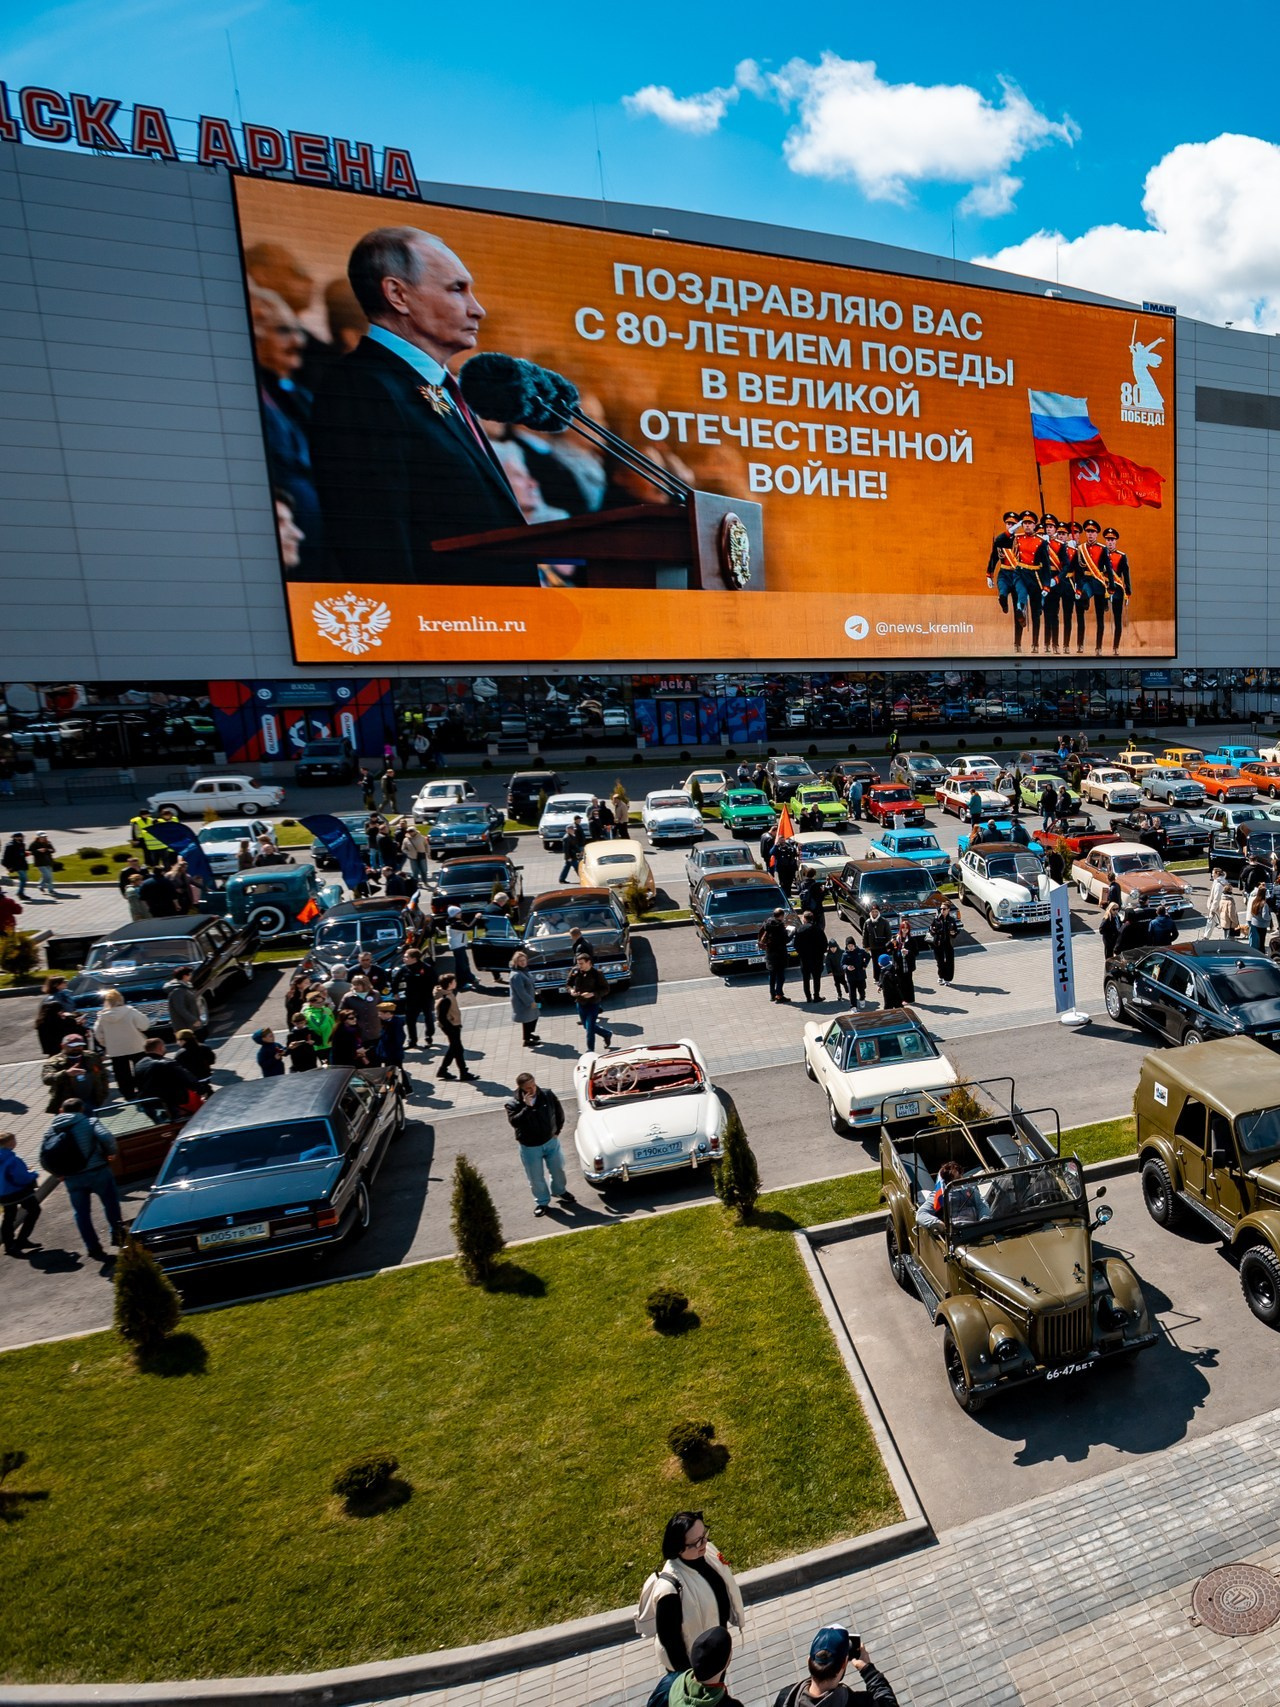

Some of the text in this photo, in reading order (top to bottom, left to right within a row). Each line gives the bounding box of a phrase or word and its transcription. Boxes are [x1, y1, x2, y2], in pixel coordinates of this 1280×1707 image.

[198, 115, 422, 199] АРЕНА
[612, 262, 983, 341] ПОЗДРАВЛЯЮ ВАС
[1150, 303, 1176, 314] MAER
[574, 307, 1015, 389] С 80-ЛЕТИЕМ ПОБЕДЫ
[701, 368, 920, 418] В ВЕЛИКОЙ
[1120, 409, 1165, 427] ПОБЕДА!
[639, 409, 974, 464] ОТЕЧЕСТВЕННОЙ
[748, 460, 888, 500] ВОЙНЕ!
[418, 616, 527, 632] kremlin.ru
[875, 621, 974, 635] @news_kremlin
[660, 679, 692, 690] ЦСКА
[1055, 918, 1069, 983] НАМИ
[637, 1147, 668, 1158] Р190КО
[204, 1230, 245, 1243] А005ТВ
[1046, 1364, 1075, 1380] 66-47
